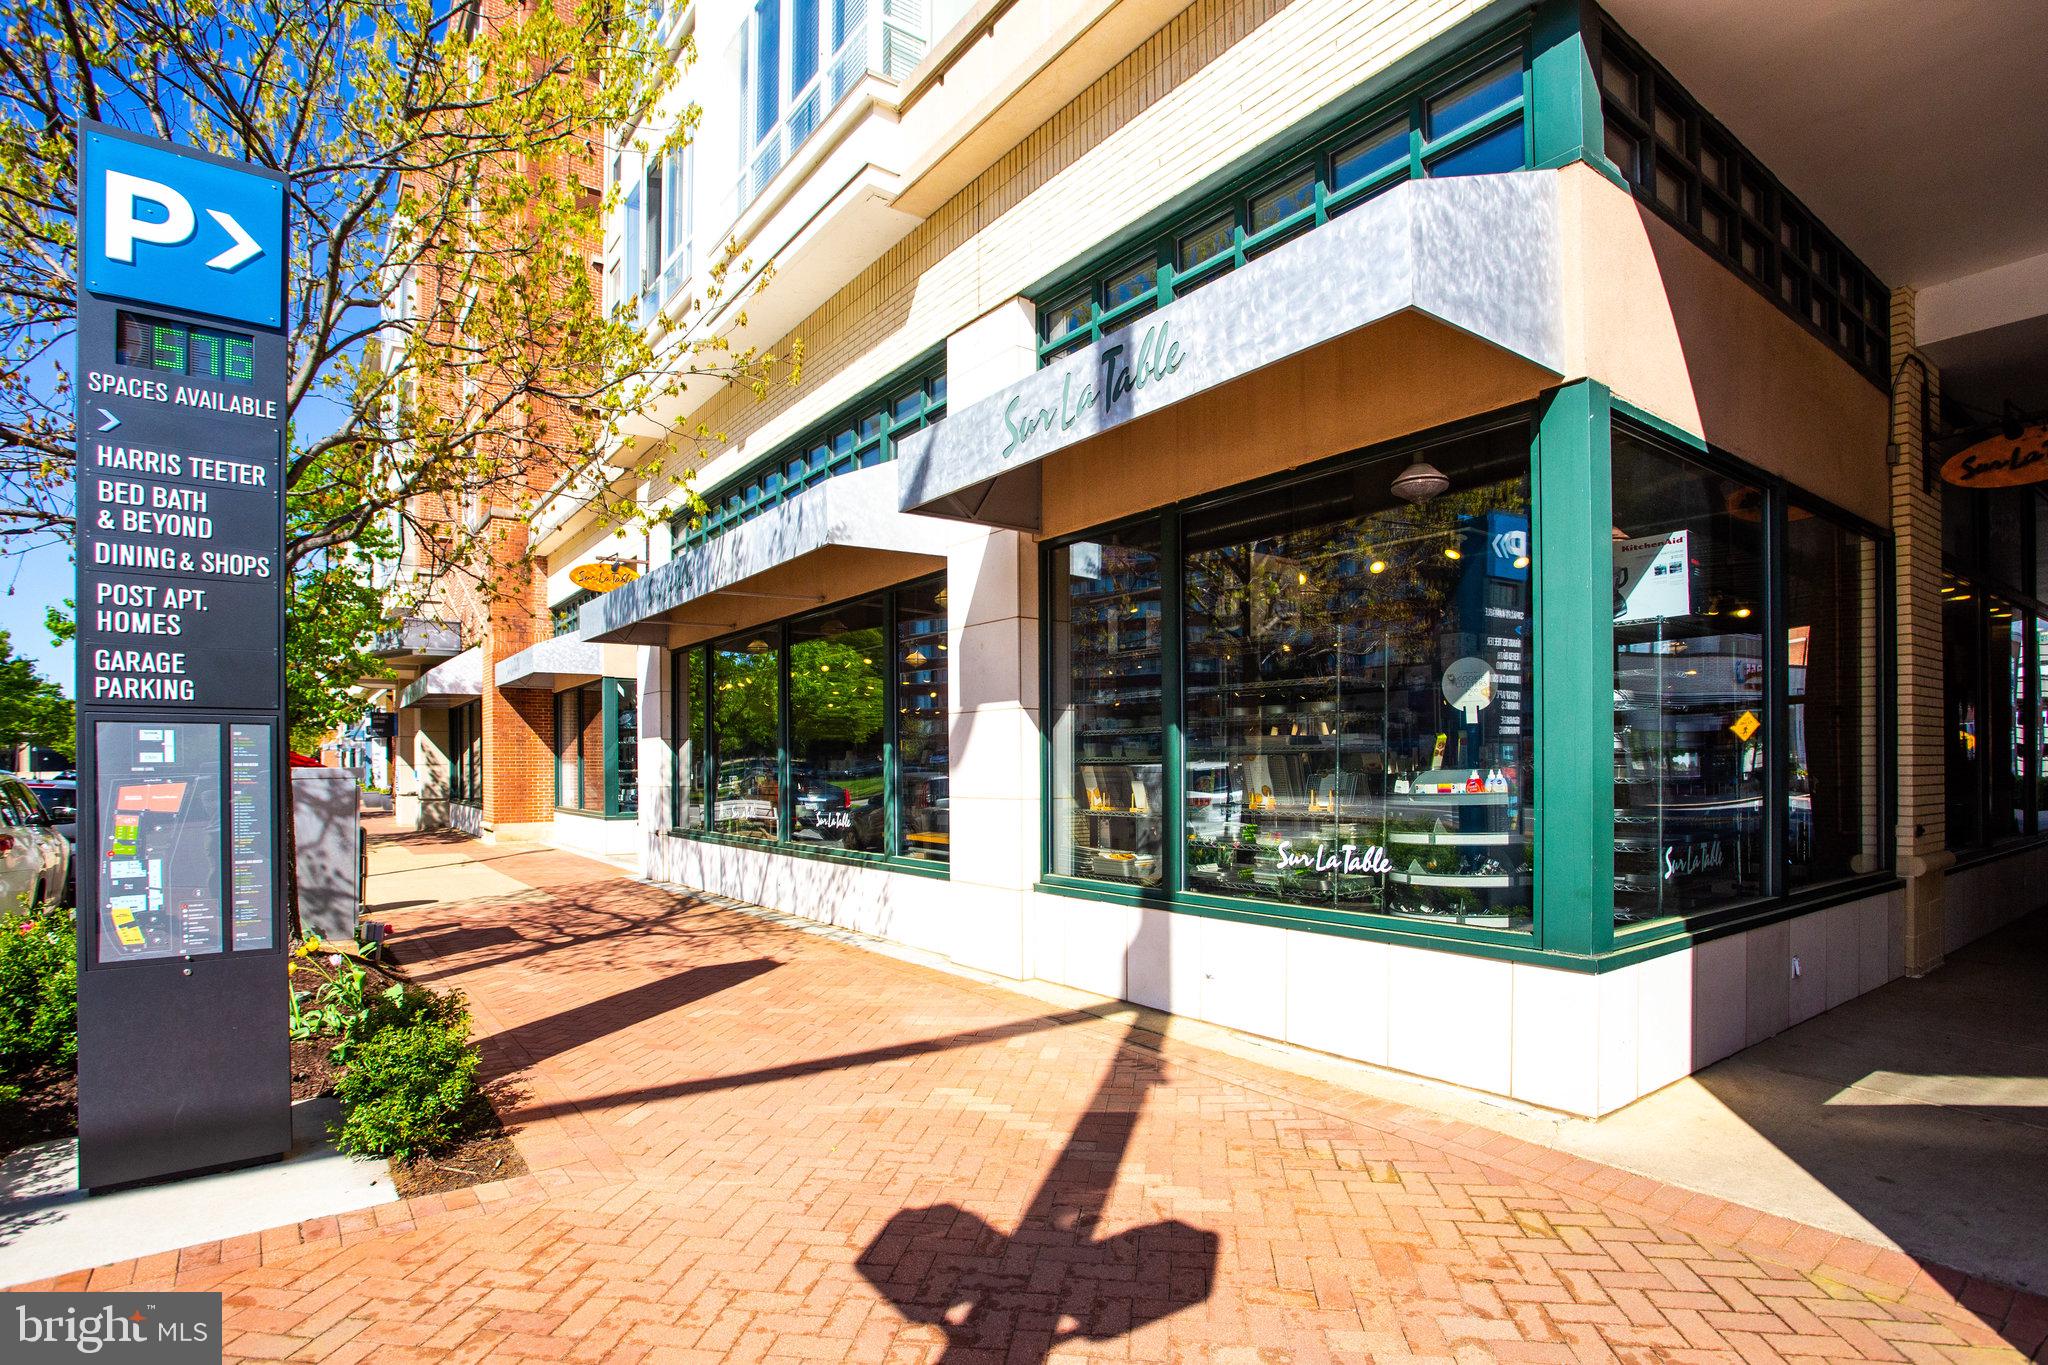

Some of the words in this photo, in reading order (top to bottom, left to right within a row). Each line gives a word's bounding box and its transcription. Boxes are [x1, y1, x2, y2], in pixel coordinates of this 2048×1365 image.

[105, 169, 195, 263] P
[154, 326, 253, 379] 576
[88, 371, 169, 402] SPACES
[175, 386, 277, 420] AVAILABLE
[1002, 395, 1058, 459] Sur
[1061, 372, 1100, 432] La
[1101, 320, 1186, 414] Table
[97, 444, 182, 476] HARRIS
[188, 456, 266, 487] TEETER
[98, 479, 145, 506] BED
[152, 486, 207, 513] BATH
[97, 509, 115, 530] &
[123, 509, 213, 539] BEYOND
[94, 541, 176, 571] DINING
[179, 552, 195, 571] &
[201, 551, 270, 578] SHOPS
[1621, 536, 1684, 553] KitchenAid
[97, 582, 157, 608] POST
[163, 587, 208, 612] APT.
[97, 610, 182, 636] HOMES
[94, 648, 186, 674] GARAGE
[94, 676, 195, 701] PARKING
[1277, 840, 1315, 869] Sur
[1315, 843, 1342, 872] La
[1341, 844, 1392, 875] Table
[1664, 846, 1687, 880] Sur
